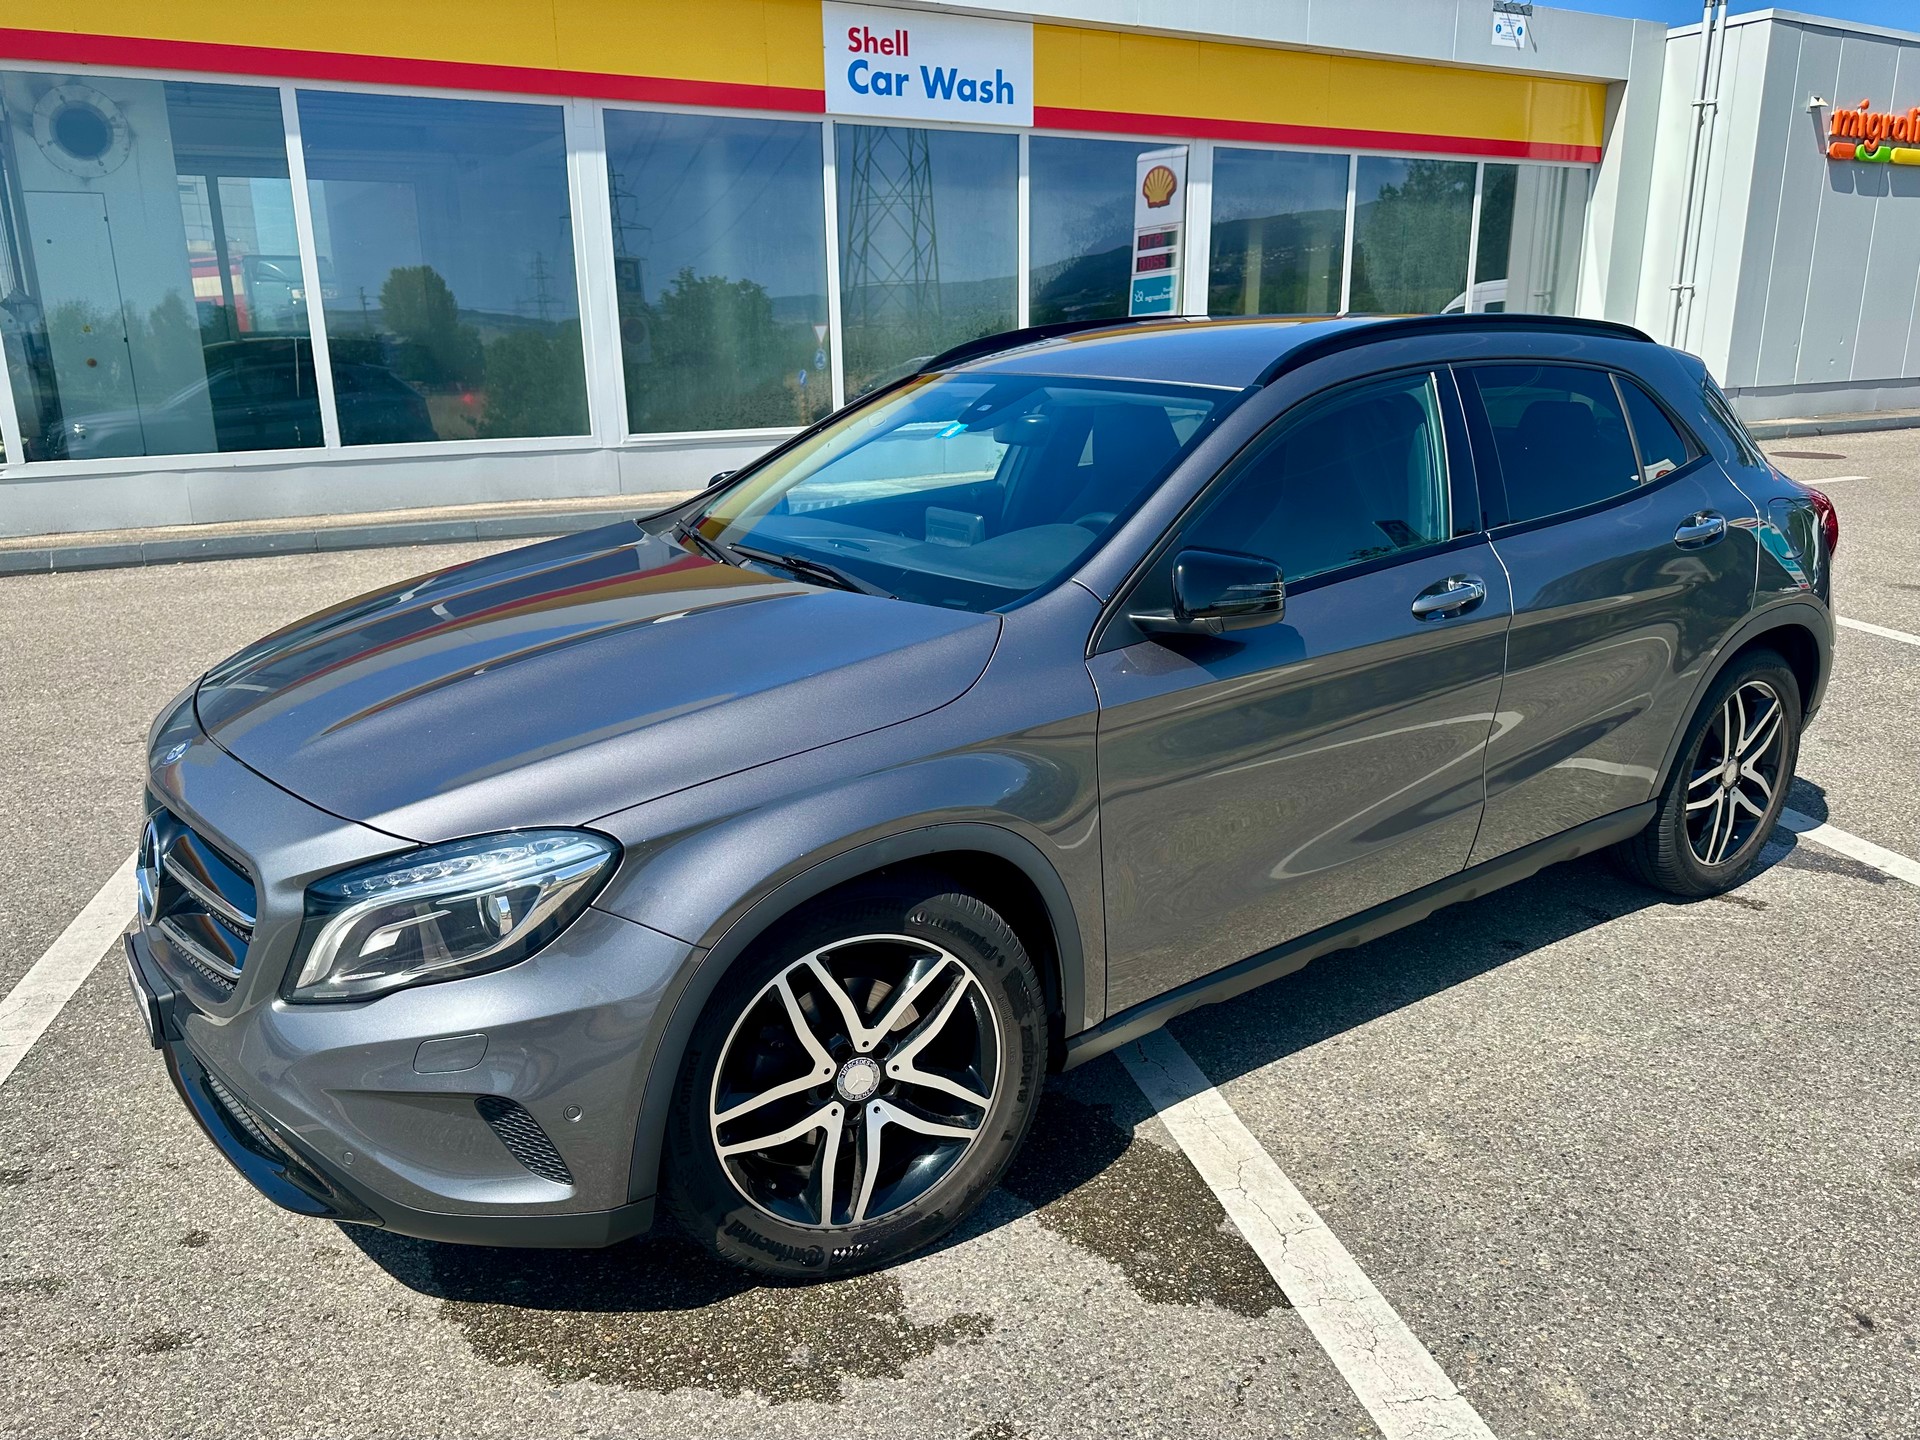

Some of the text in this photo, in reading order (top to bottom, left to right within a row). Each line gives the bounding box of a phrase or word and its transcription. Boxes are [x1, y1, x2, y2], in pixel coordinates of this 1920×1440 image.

[848, 26, 909, 56] Shell
[847, 59, 1014, 105] Car Wash
[841, 1059, 871, 1076] MERCEDES
